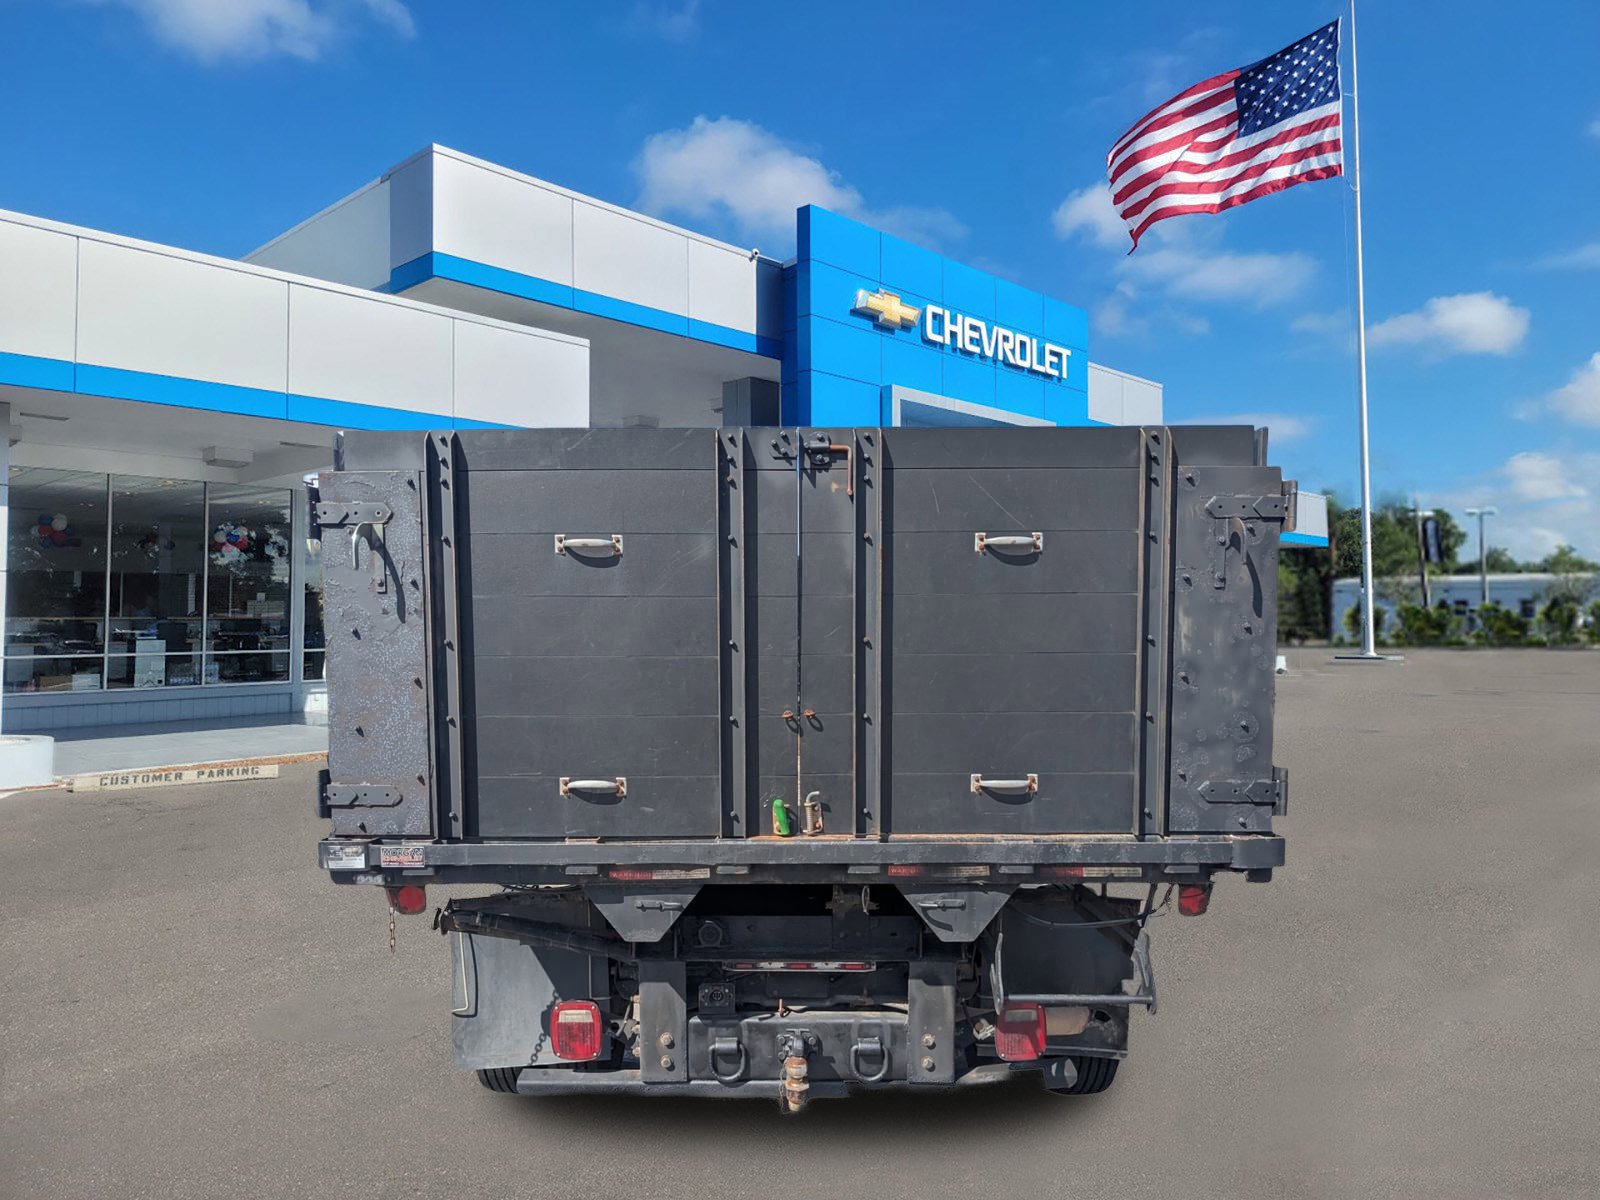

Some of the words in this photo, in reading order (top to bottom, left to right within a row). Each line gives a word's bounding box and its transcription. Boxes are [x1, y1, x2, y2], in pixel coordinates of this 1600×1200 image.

[925, 304, 1072, 379] CHEVROLET
[100, 772, 183, 787] CUSTOMER
[197, 766, 260, 779] PARKING
